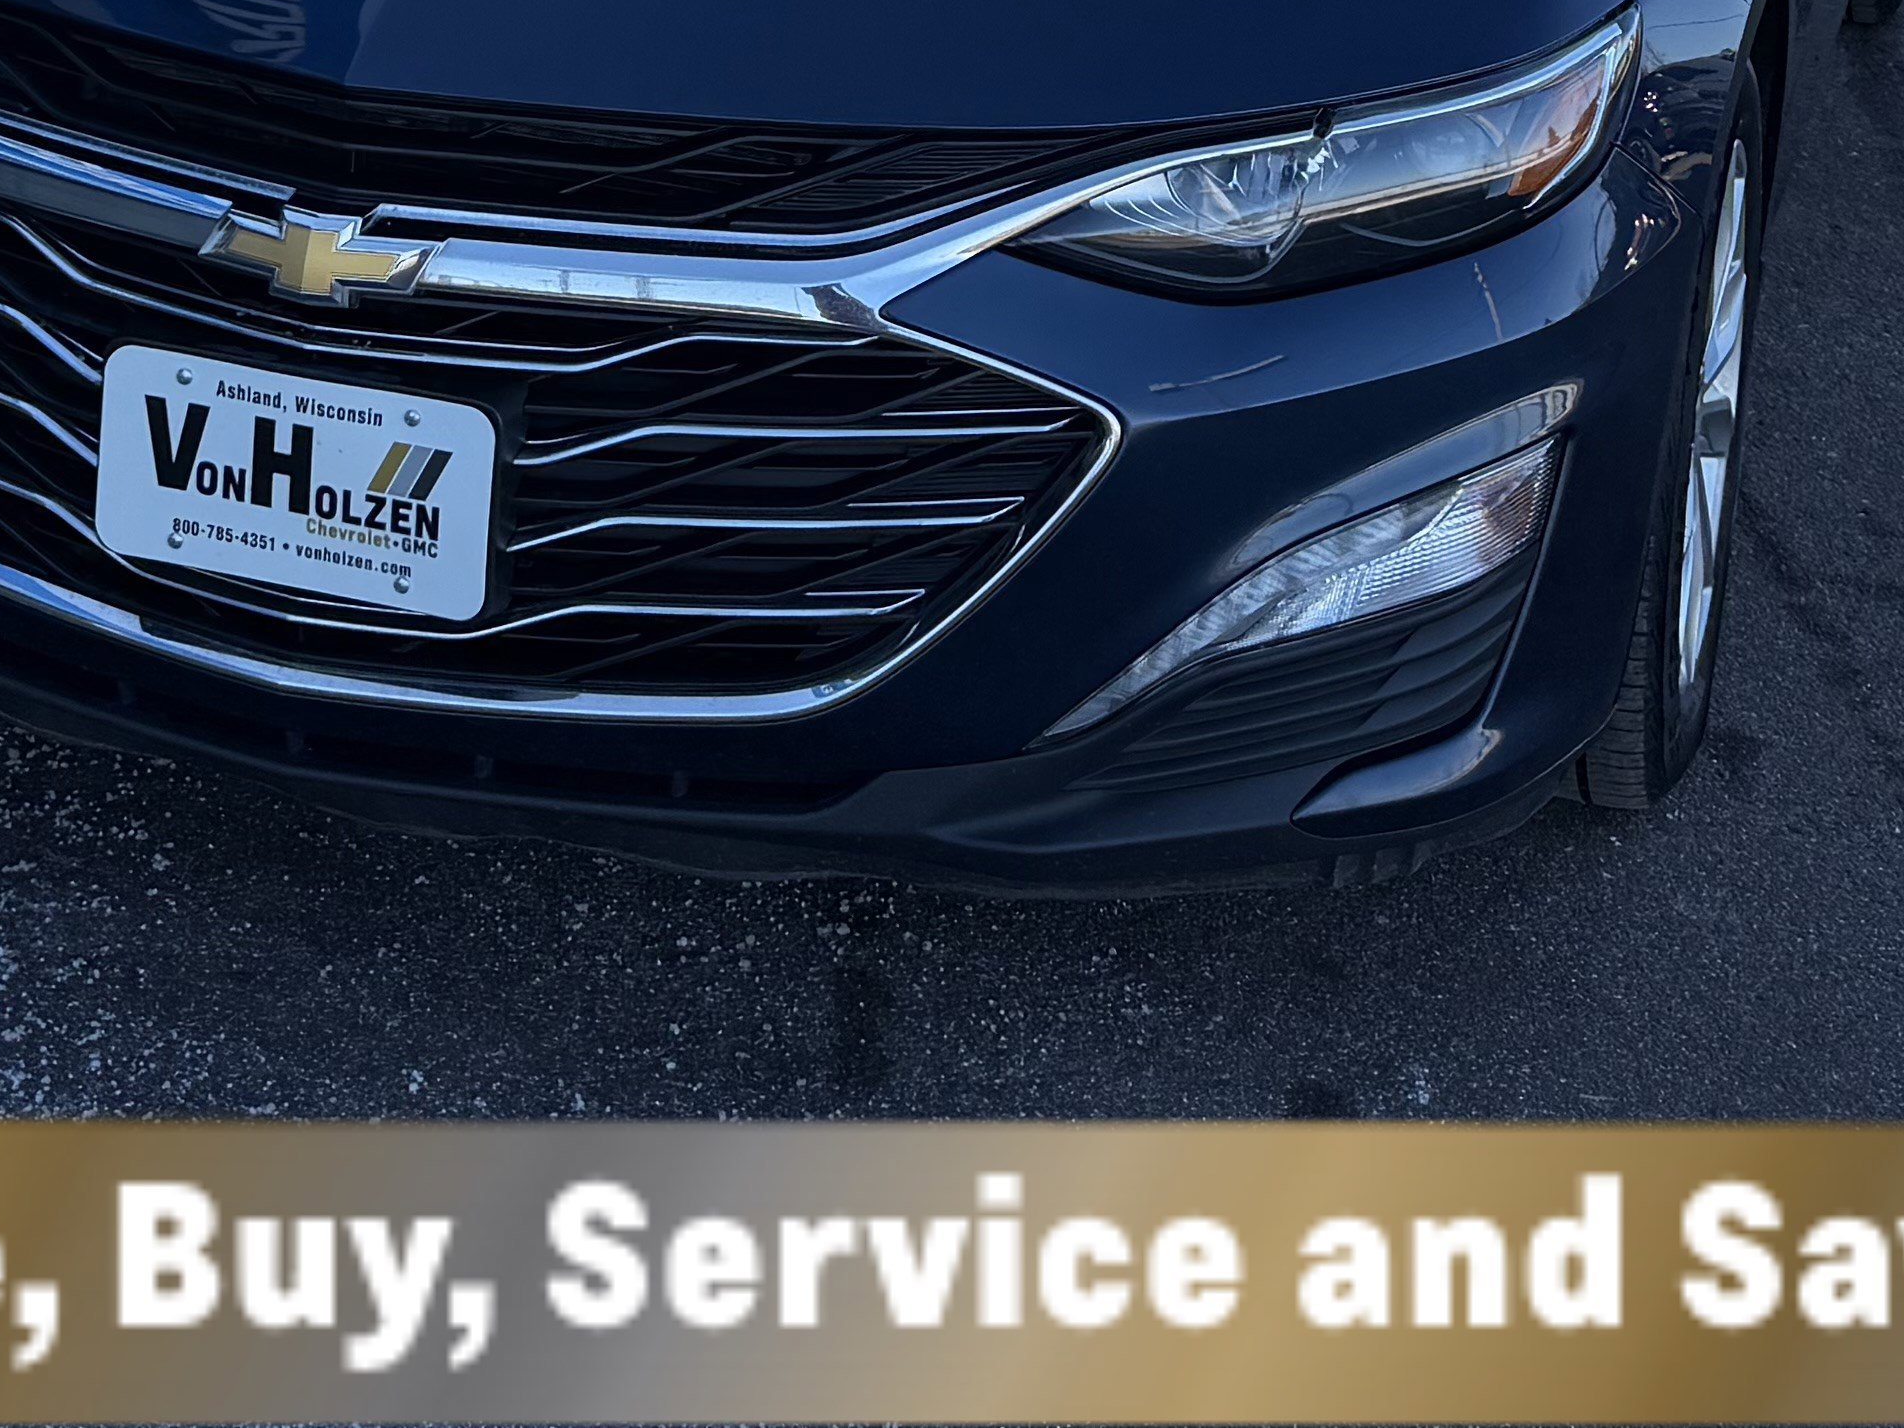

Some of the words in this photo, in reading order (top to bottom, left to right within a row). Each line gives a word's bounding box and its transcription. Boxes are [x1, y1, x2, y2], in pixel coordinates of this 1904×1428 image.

[216, 380, 287, 413] Ashland,
[295, 395, 384, 428] Wisconsin
[172, 517, 276, 552] 800-785-4351
[295, 544, 412, 578] vonholzen.com
